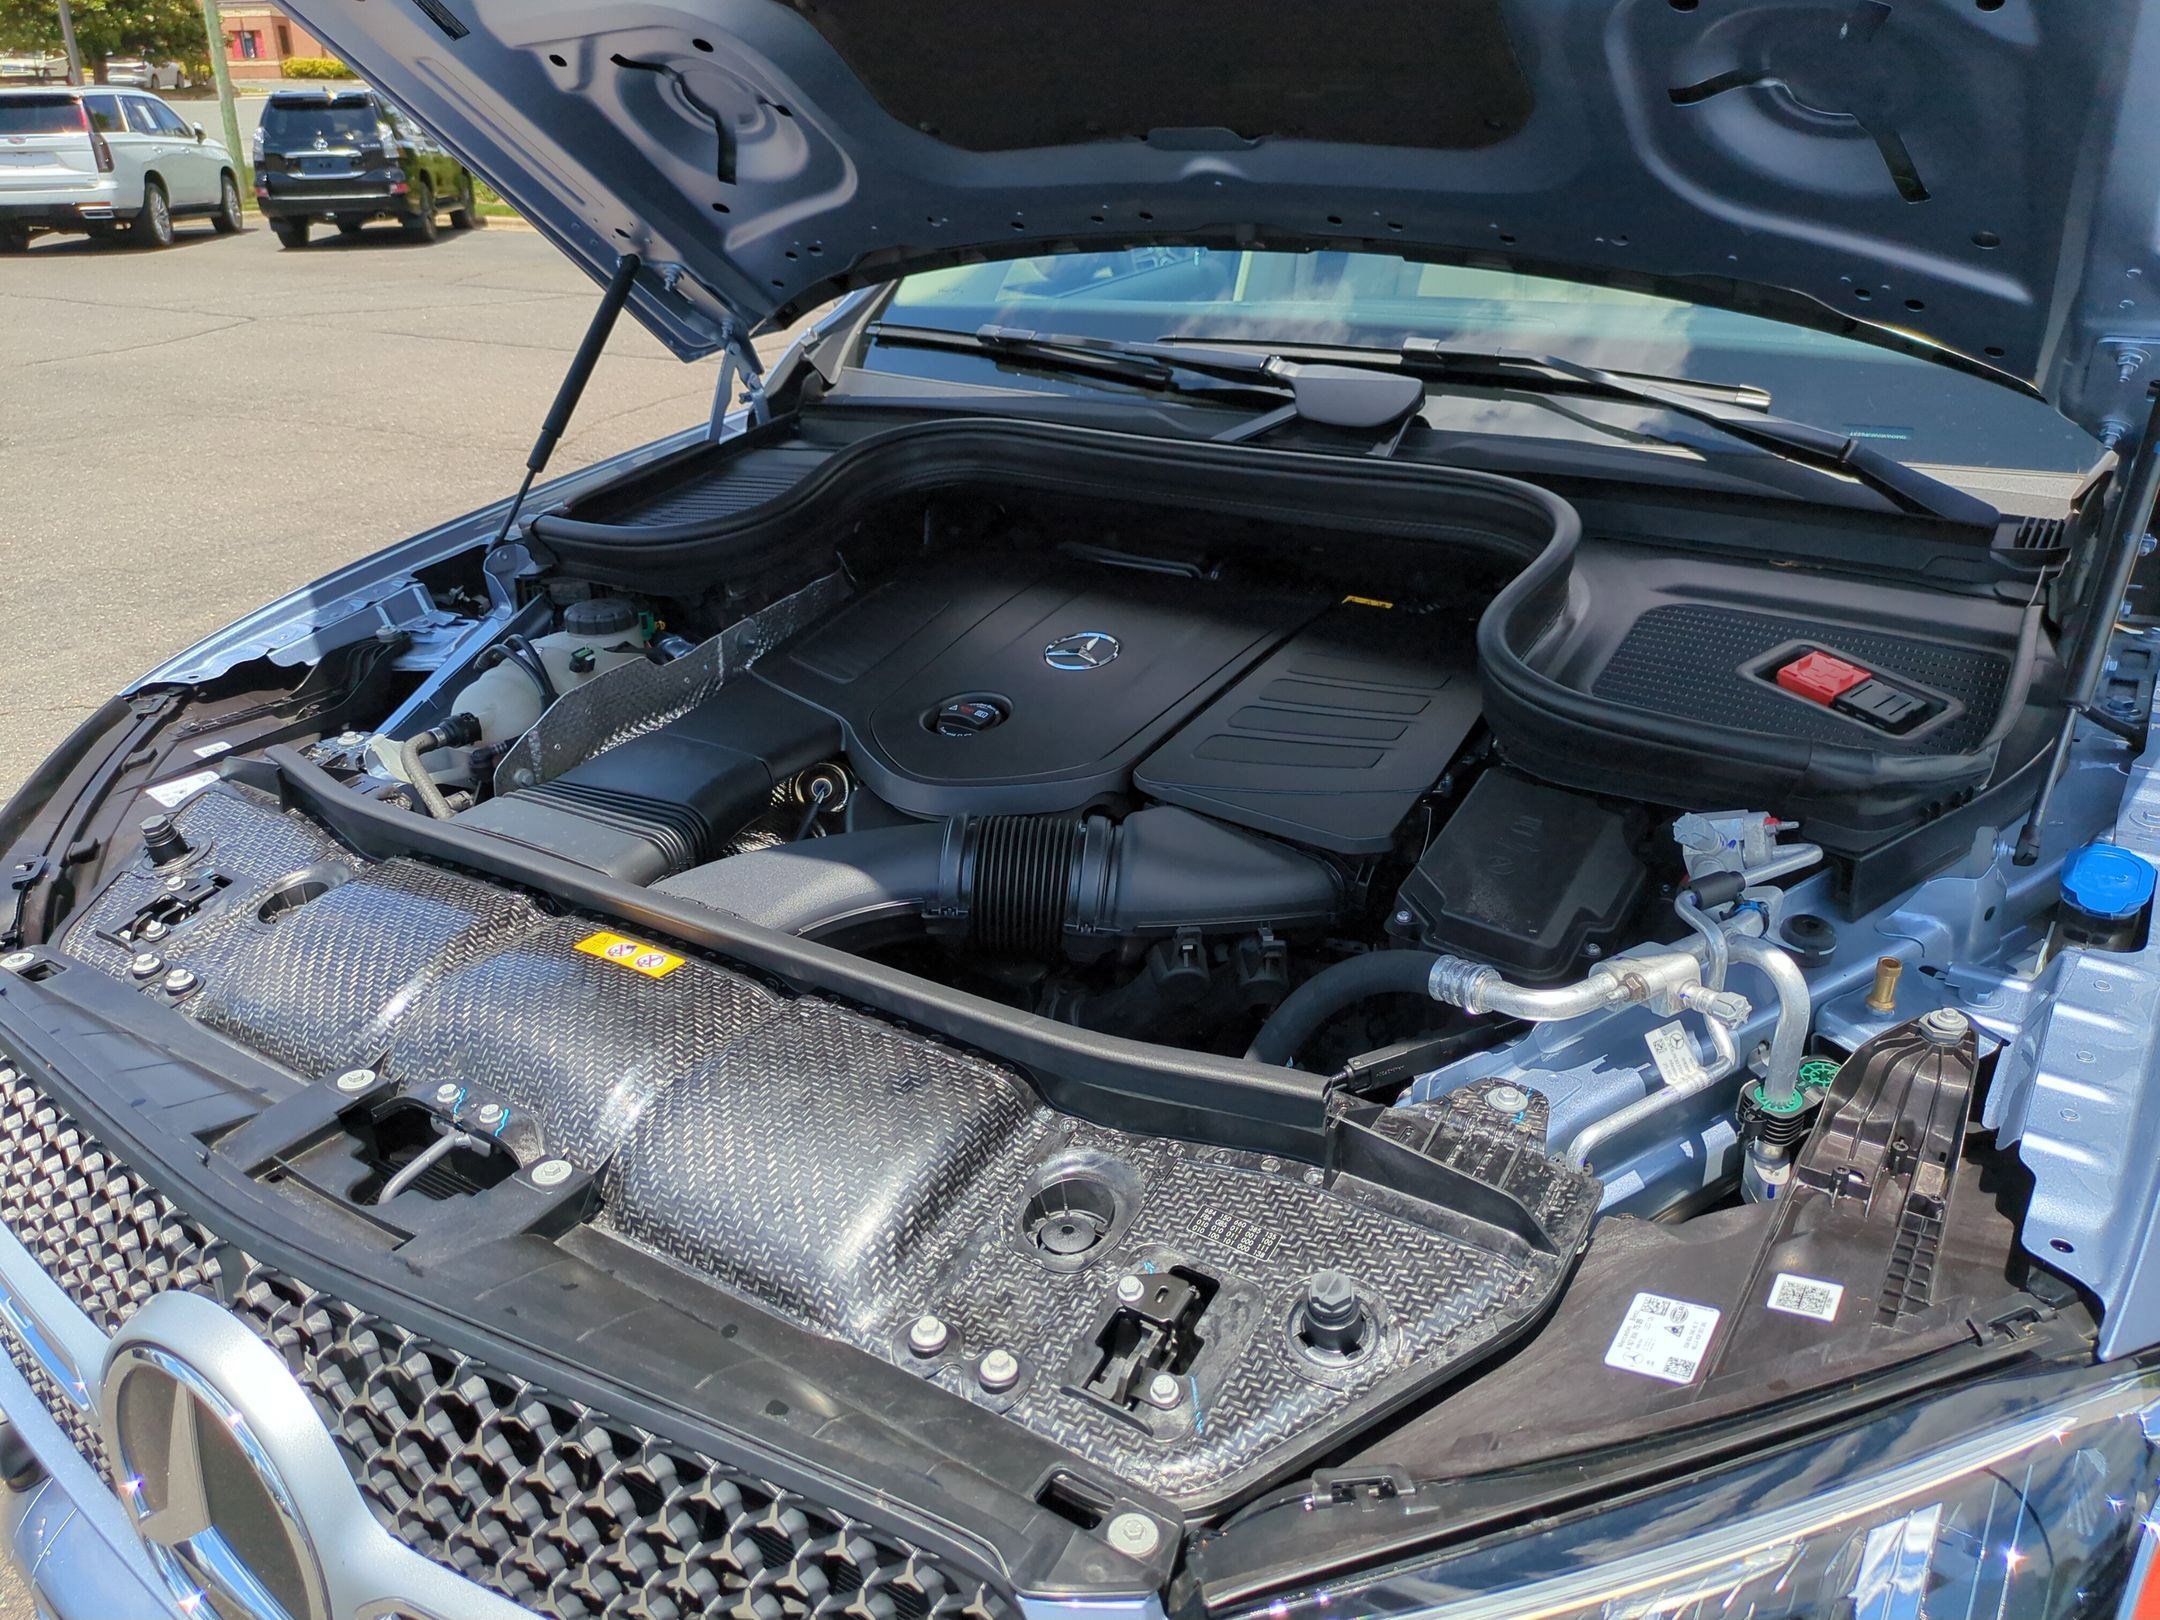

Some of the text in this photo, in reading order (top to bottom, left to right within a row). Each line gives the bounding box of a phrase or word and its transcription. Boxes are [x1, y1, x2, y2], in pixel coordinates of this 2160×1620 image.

[1192, 1225, 1205, 1234] 010
[1208, 1231, 1220, 1240] 100
[1223, 1237, 1235, 1246] 101
[1236, 1243, 1250, 1252] 000
[1196, 1219, 1269, 1252] 010 010 011 000 111
[1220, 1213, 1232, 1222] 150
[1233, 1219, 1247, 1228] 660
[1248, 1225, 1262, 1234] 385
[1265, 1231, 1277, 1240] 135
[1230, 1225, 1243, 1234] 011
[1244, 1231, 1258, 1240] 001
[1261, 1237, 1273, 1246] 100
